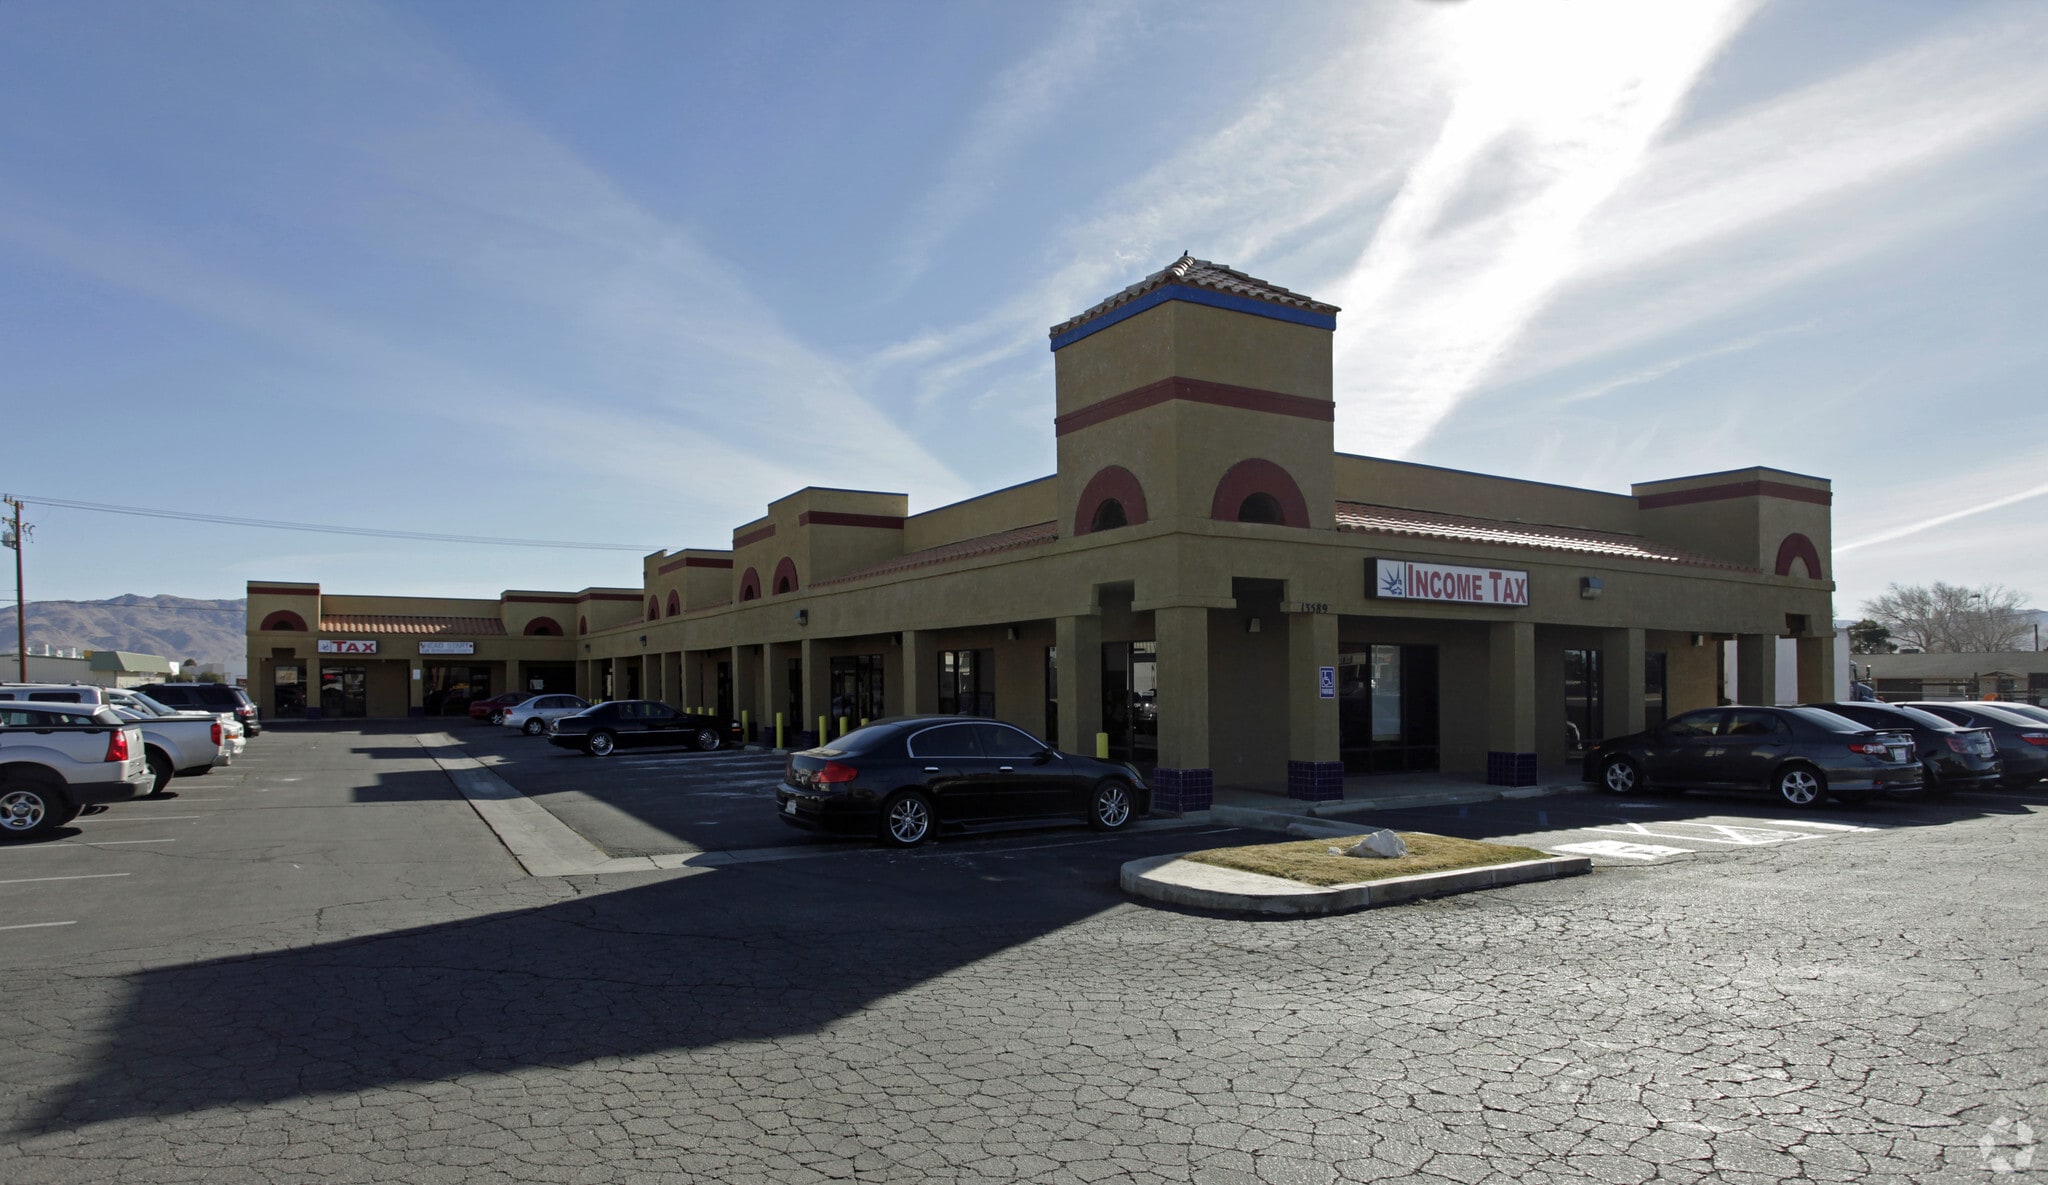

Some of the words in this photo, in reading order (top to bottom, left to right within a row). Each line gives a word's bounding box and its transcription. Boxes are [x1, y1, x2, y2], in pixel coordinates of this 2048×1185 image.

[1408, 564, 1483, 601] INCOME
[1489, 571, 1527, 603] TAX
[1301, 602, 1328, 613] 13589
[332, 641, 374, 652] TAX
